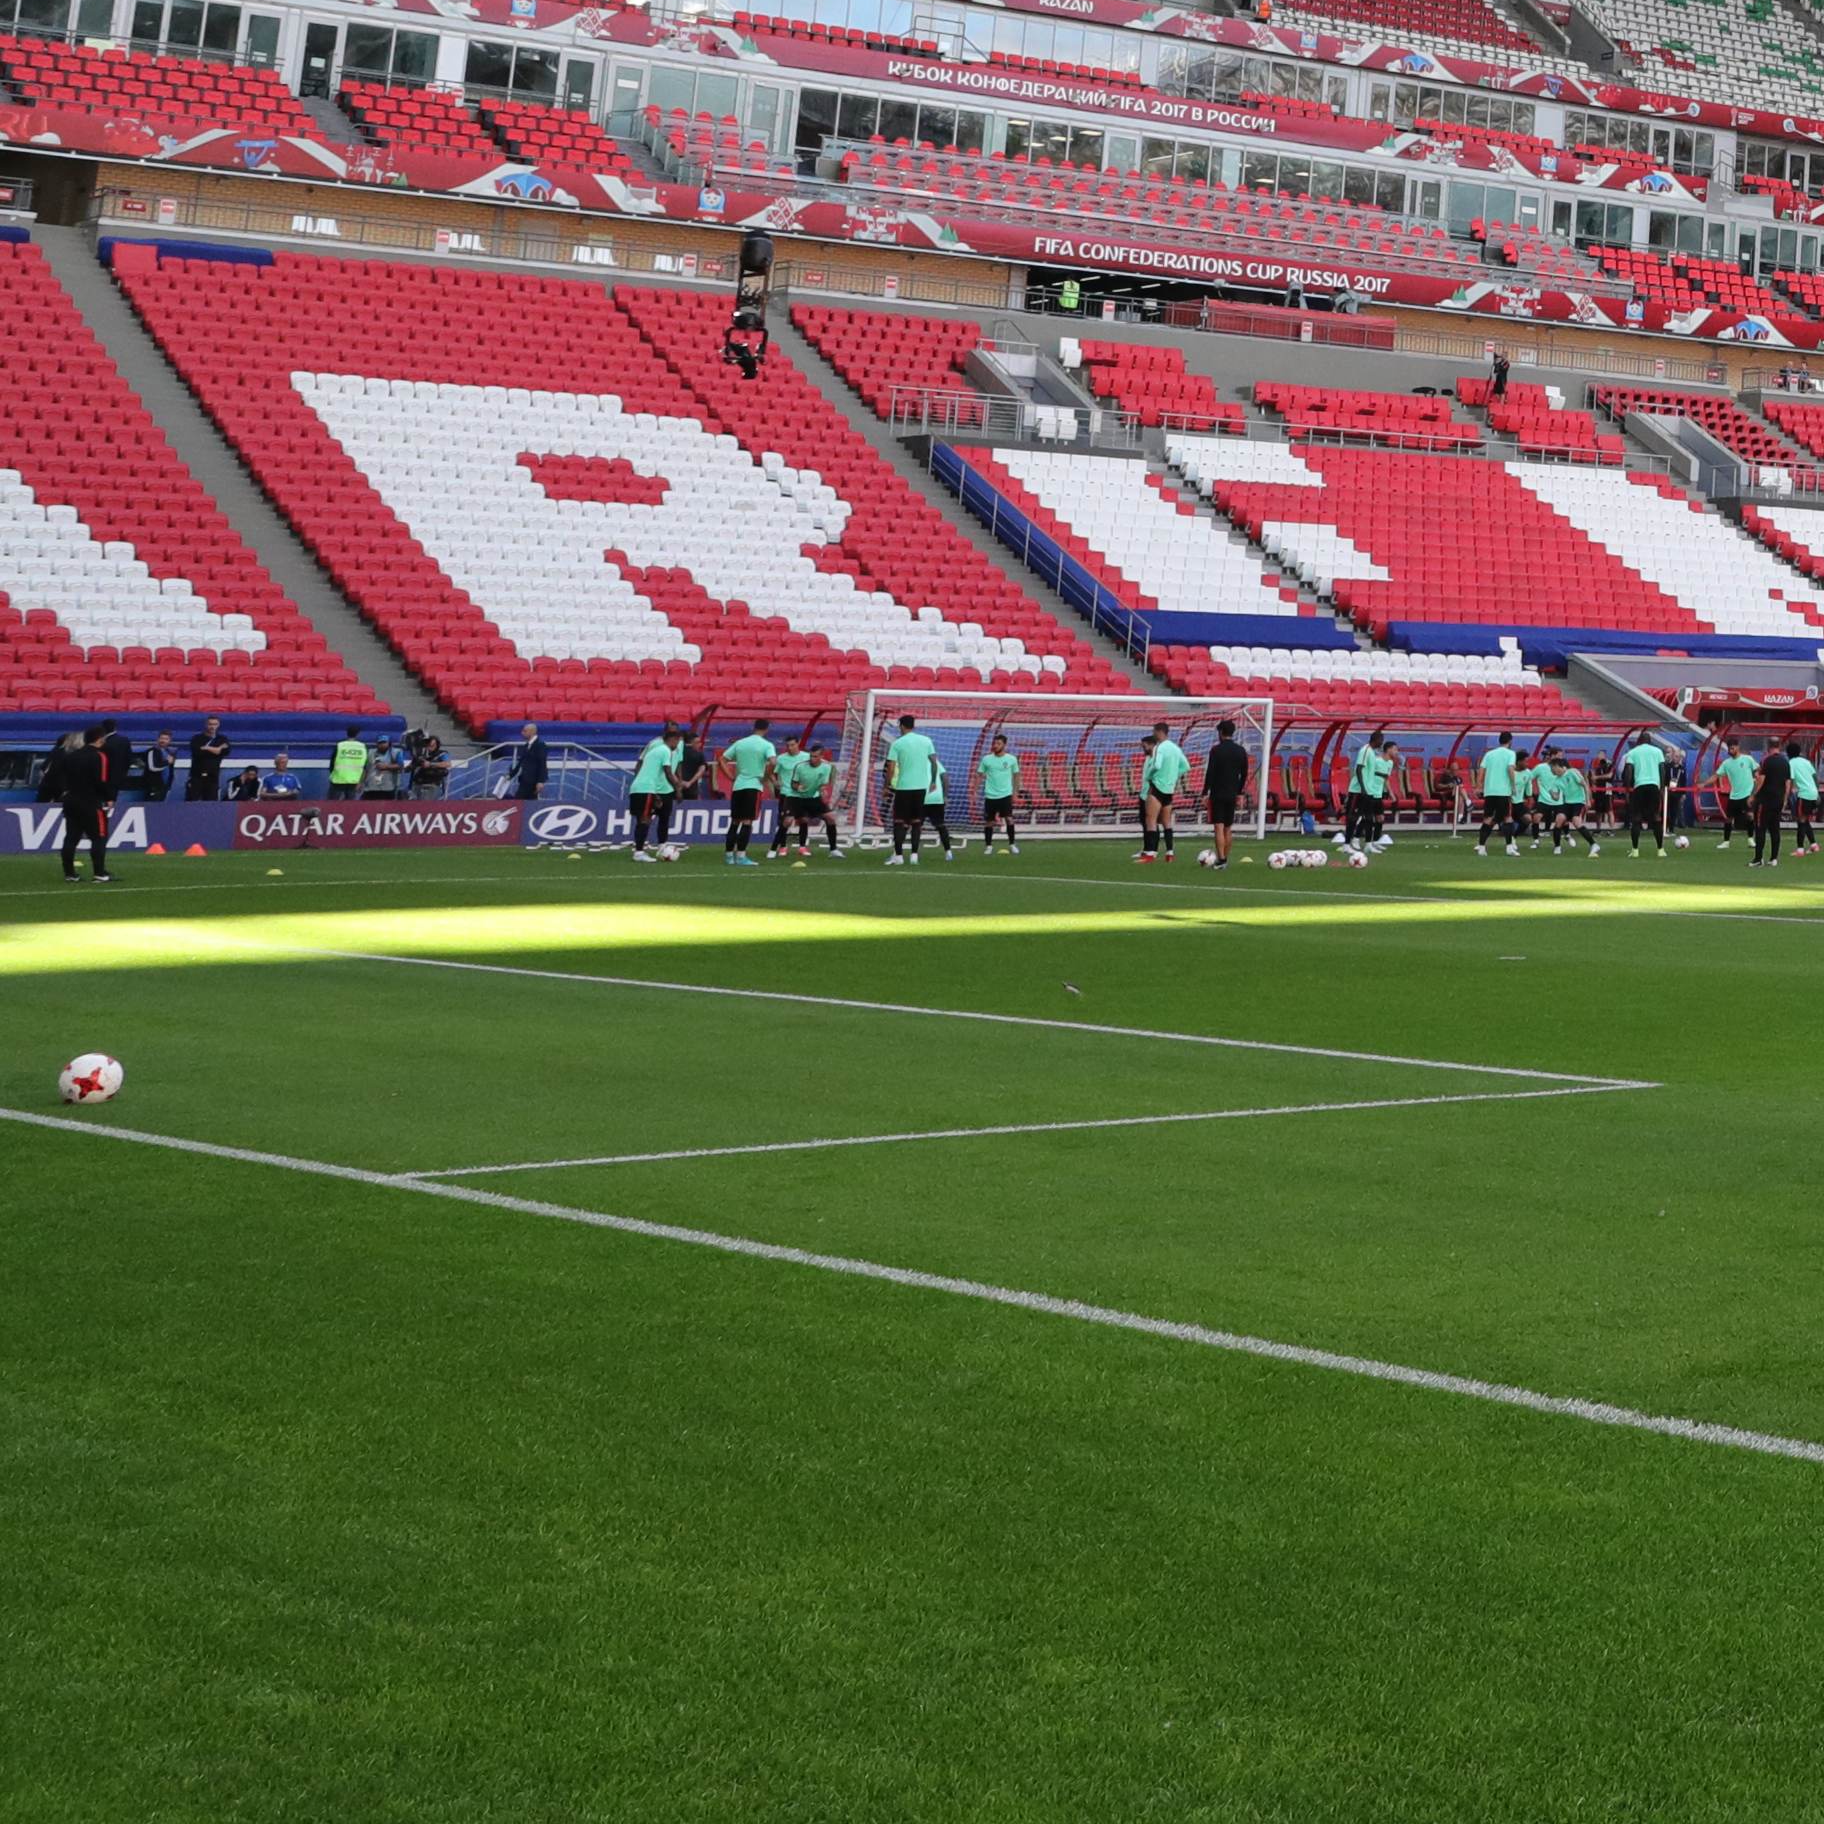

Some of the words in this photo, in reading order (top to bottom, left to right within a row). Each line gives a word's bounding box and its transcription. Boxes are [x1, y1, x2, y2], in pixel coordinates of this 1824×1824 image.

[888, 60, 953, 84] КУБОК
[957, 70, 1107, 106] КОНФЕДЕРАЦИЙ
[1109, 95, 1147, 113] FIFA
[1150, 100, 1187, 119] 2017
[1191, 106, 1203, 121] В
[1207, 109, 1277, 133] РОССИИ
[1034, 236, 1075, 257] FIFA
[1078, 241, 1243, 277] CONFEDERATIONS
[1246, 262, 1283, 280] CUP
[1287, 267, 1350, 290] RUSSIA
[1353, 275, 1391, 293] 2017
[5, 806, 148, 850] VIA
[239, 812, 345, 841] QATAR
[352, 811, 478, 835] AIRWAYS
